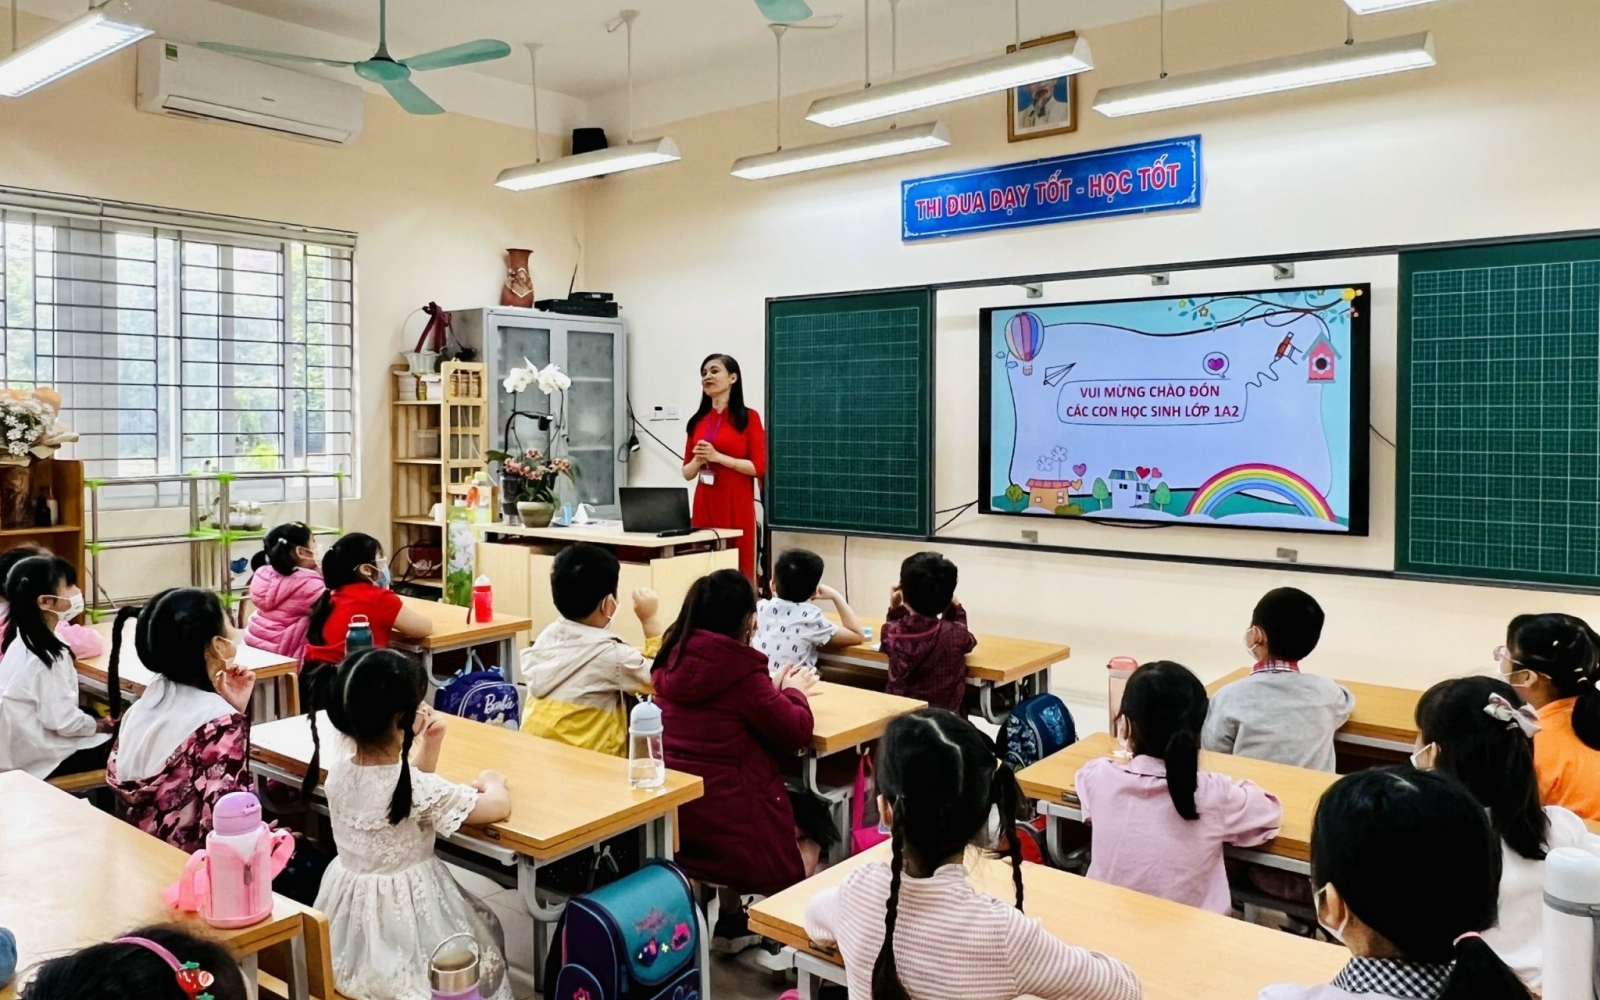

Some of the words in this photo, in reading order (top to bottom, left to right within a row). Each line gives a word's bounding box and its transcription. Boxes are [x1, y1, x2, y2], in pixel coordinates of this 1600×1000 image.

[915, 199, 942, 220] THI
[945, 192, 984, 216] ĐUA
[990, 184, 1029, 215] DẠY
[1034, 170, 1072, 203] TỐT
[1089, 170, 1132, 202] HỌC
[1138, 153, 1181, 192] TỐT
[1080, 387, 1100, 398] VUI
[1104, 384, 1145, 398] MỪNG
[1150, 384, 1185, 398] CHÀO
[1189, 382, 1220, 398] ĐÓN
[1066, 404, 1088, 417] CÁC
[1092, 405, 1117, 417] CON
[1121, 405, 1148, 419] HỌC
[1151, 406, 1181, 417] SINH
[1185, 402, 1210, 417] LỚP
[1214, 405, 1239, 417] 1A2
